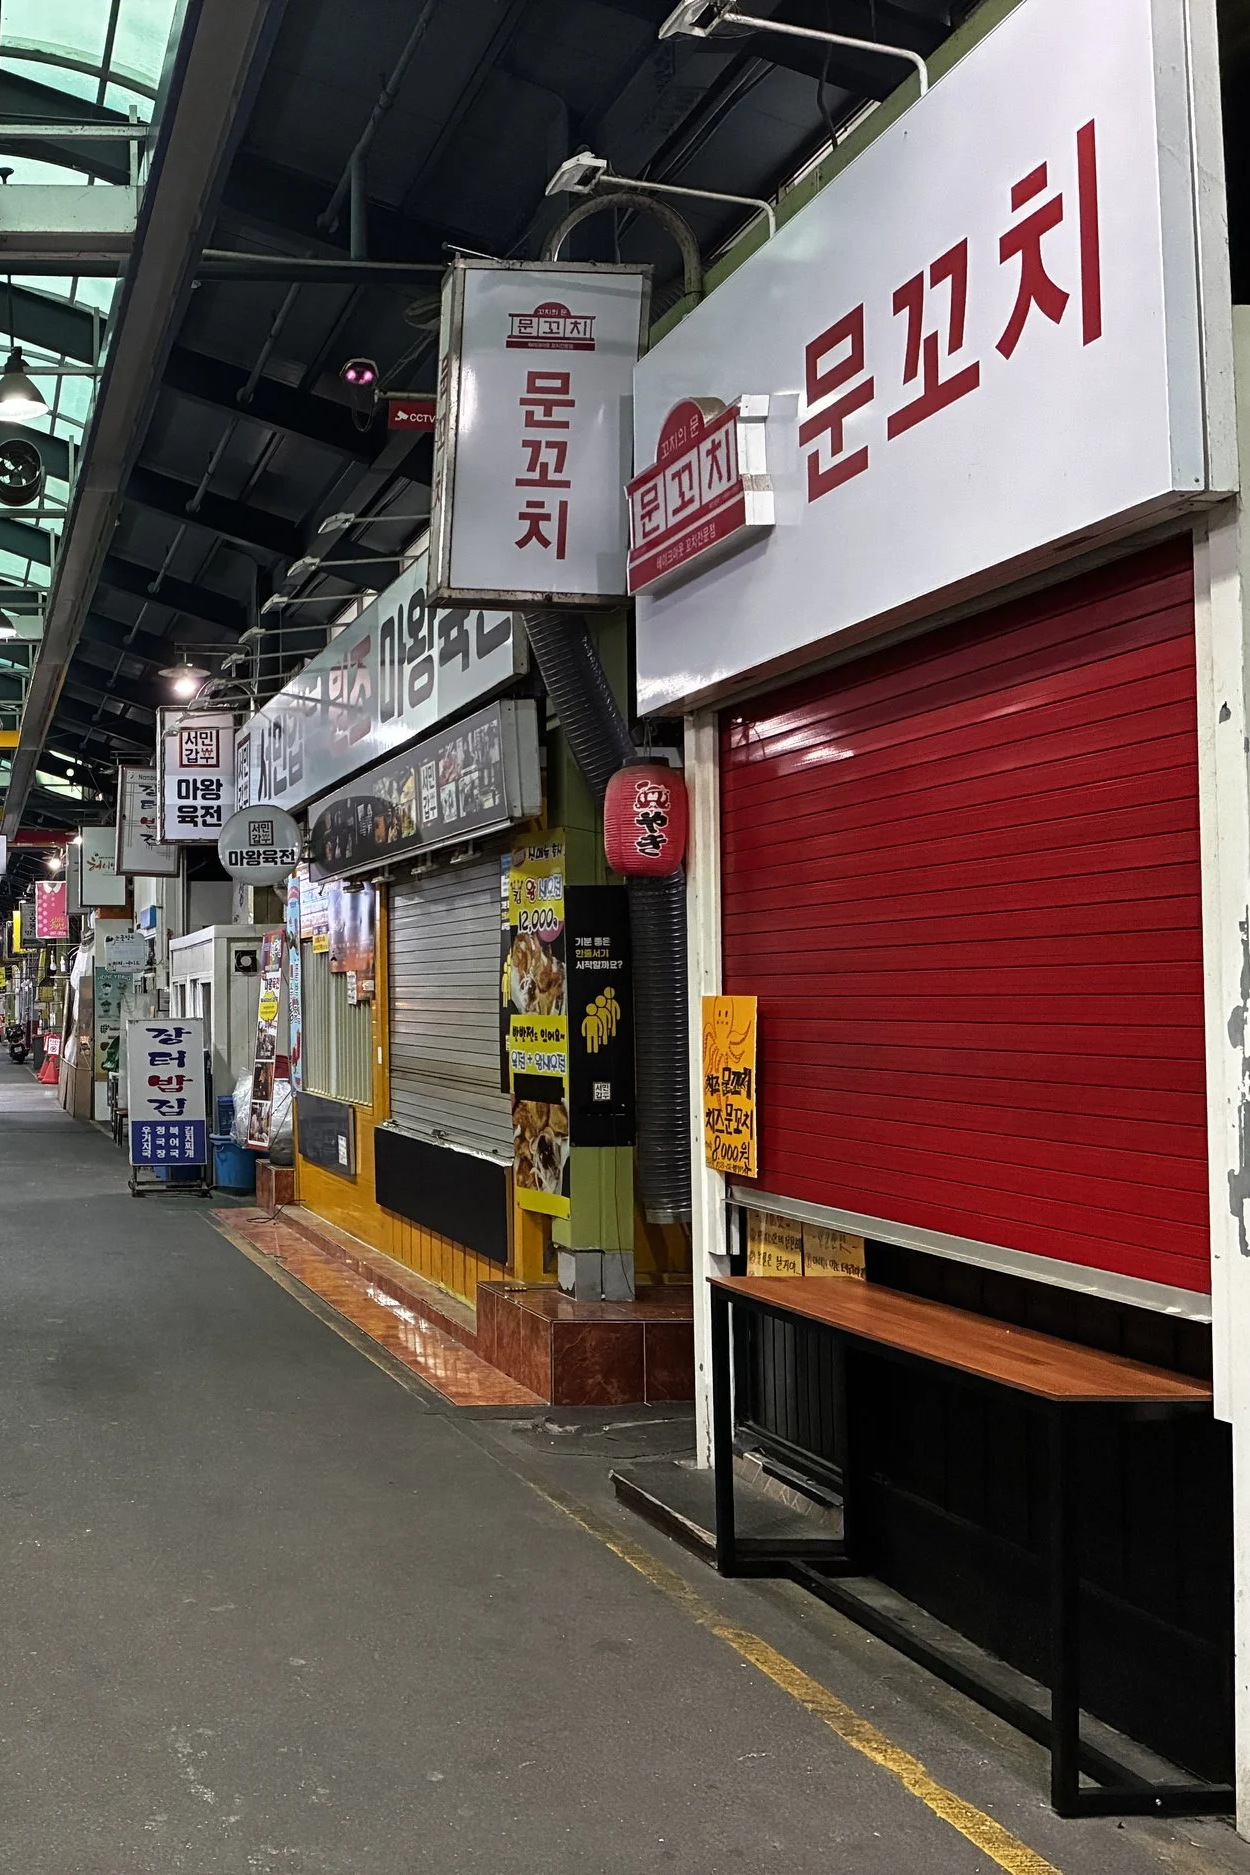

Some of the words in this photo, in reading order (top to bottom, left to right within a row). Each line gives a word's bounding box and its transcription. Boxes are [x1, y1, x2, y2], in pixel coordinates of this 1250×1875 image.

[798, 118, 1103, 504] 문꼬치
[517, 318, 588, 336] 문꼬치
[410, 413, 436, 423] CCTV
[661, 427, 687, 460] 꼬치의
[689, 414, 699, 437] 문
[515, 370, 575, 560] 문꼬치
[640, 428, 732, 540] 문꼬치
[184, 731, 213, 747] 서민
[184, 748, 214, 763] 갑부
[177, 778, 223, 801] 마왕
[176, 805, 223, 828] 육전
[252, 823, 271, 834] 서민
[228, 849, 296, 867] 마왕육전
[575, 937, 592, 947] 기분
[146, 1026, 193, 1117] 장터밥집
[141, 1126, 151, 1158] 우거지국
[169, 1126, 179, 1158] 북어국
